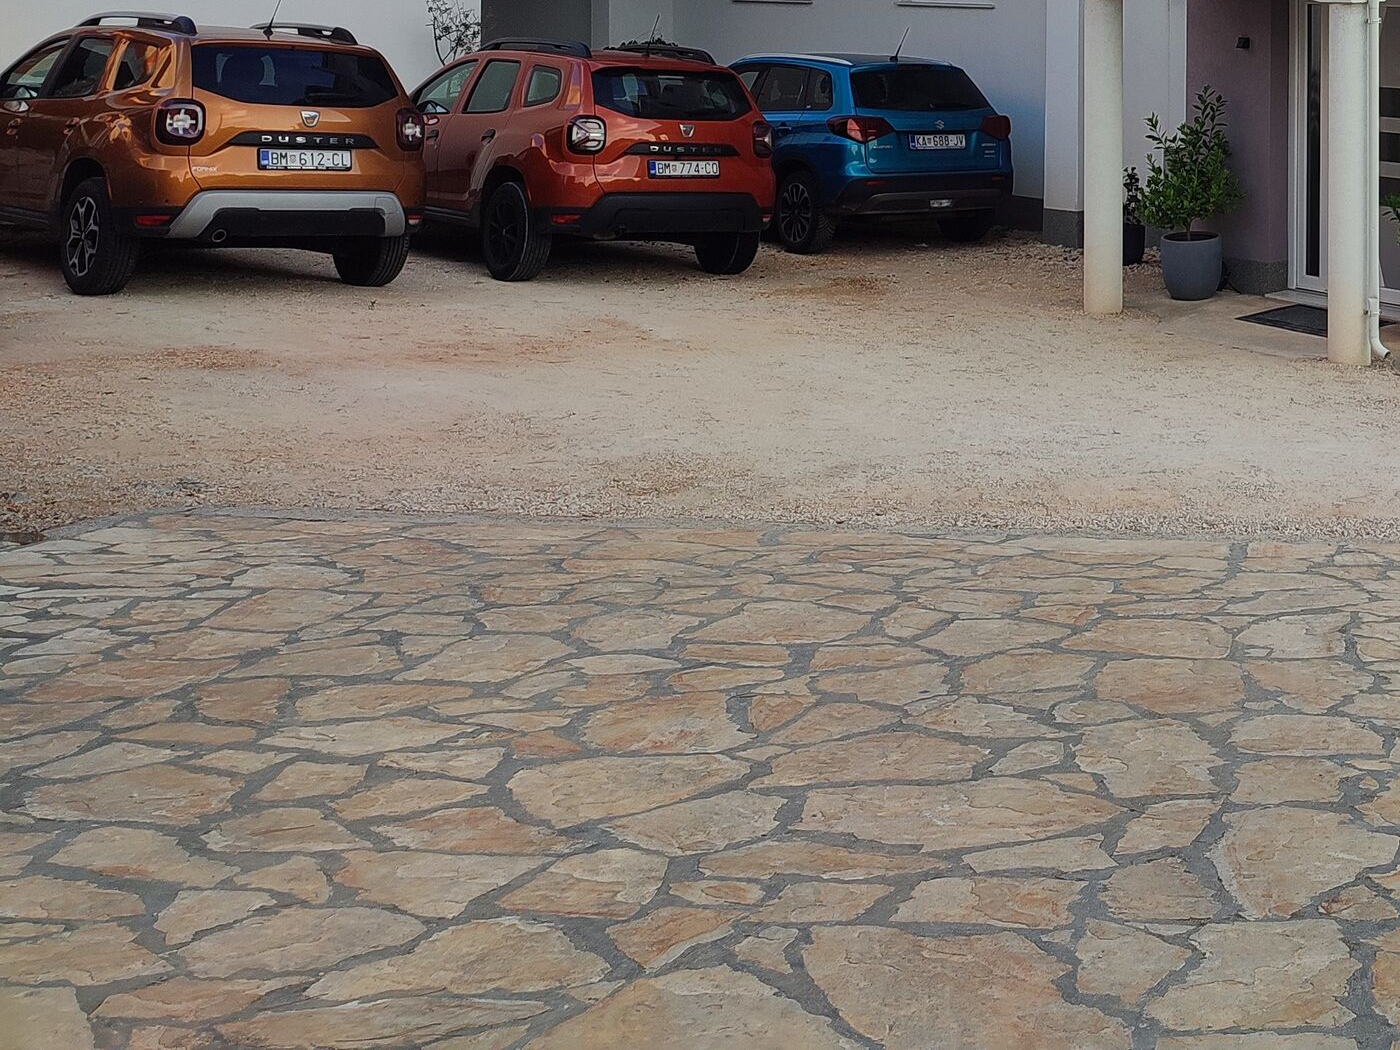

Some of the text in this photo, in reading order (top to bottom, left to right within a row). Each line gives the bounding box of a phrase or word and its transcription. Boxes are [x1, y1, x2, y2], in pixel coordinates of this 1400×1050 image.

[261, 135, 355, 145] DUSTER
[916, 134, 927, 147] KA
[271, 152, 348, 167] BM 612-CL
[657, 162, 671, 175] BM
